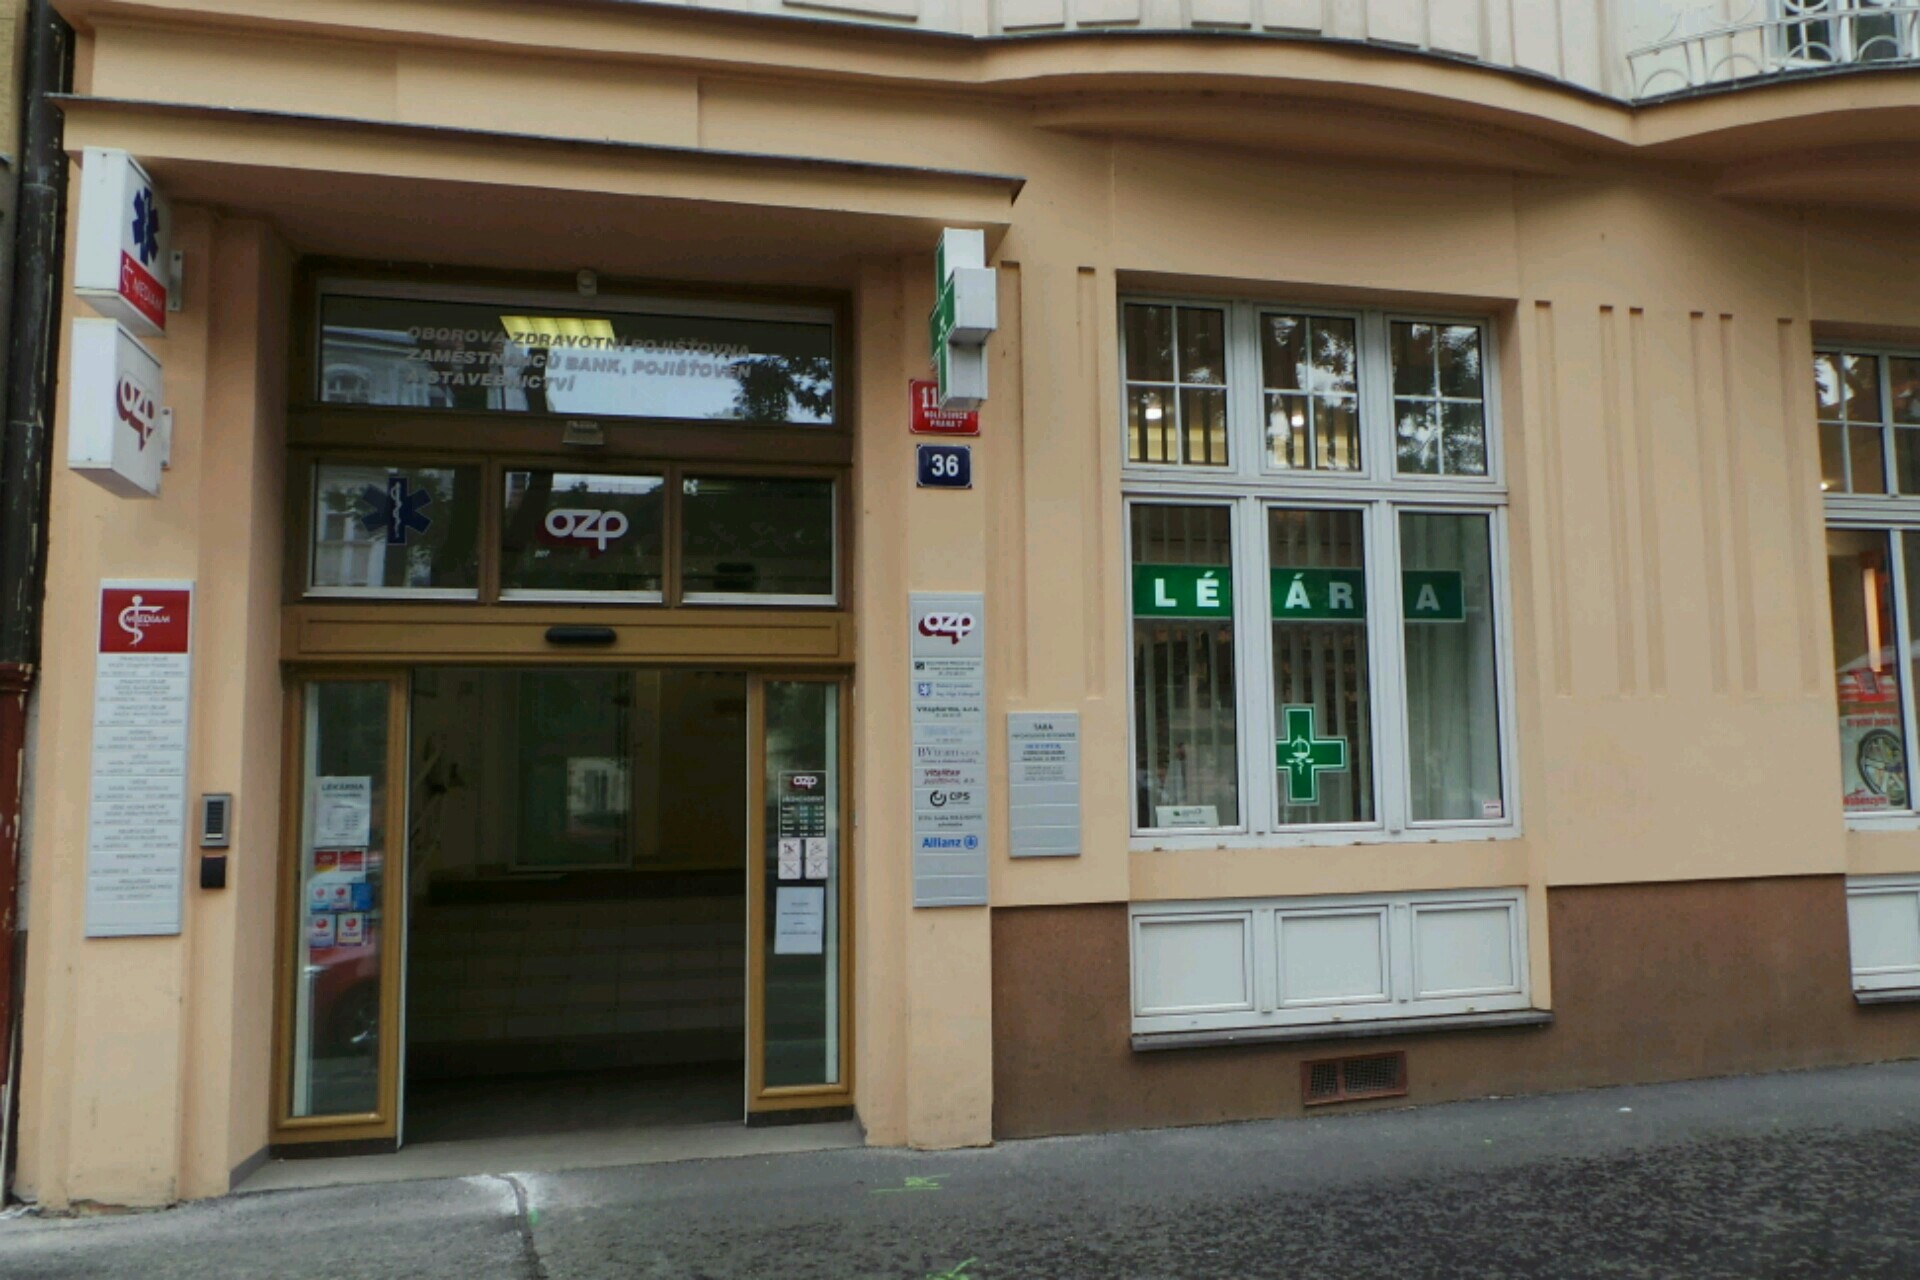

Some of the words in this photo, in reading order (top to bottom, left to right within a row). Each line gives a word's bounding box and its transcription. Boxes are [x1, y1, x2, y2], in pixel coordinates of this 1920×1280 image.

[512, 331, 627, 351] ZDRAVOTNÍ
[931, 454, 959, 477] 36
[543, 508, 629, 552] ozp
[922, 837, 962, 848] Allianz
